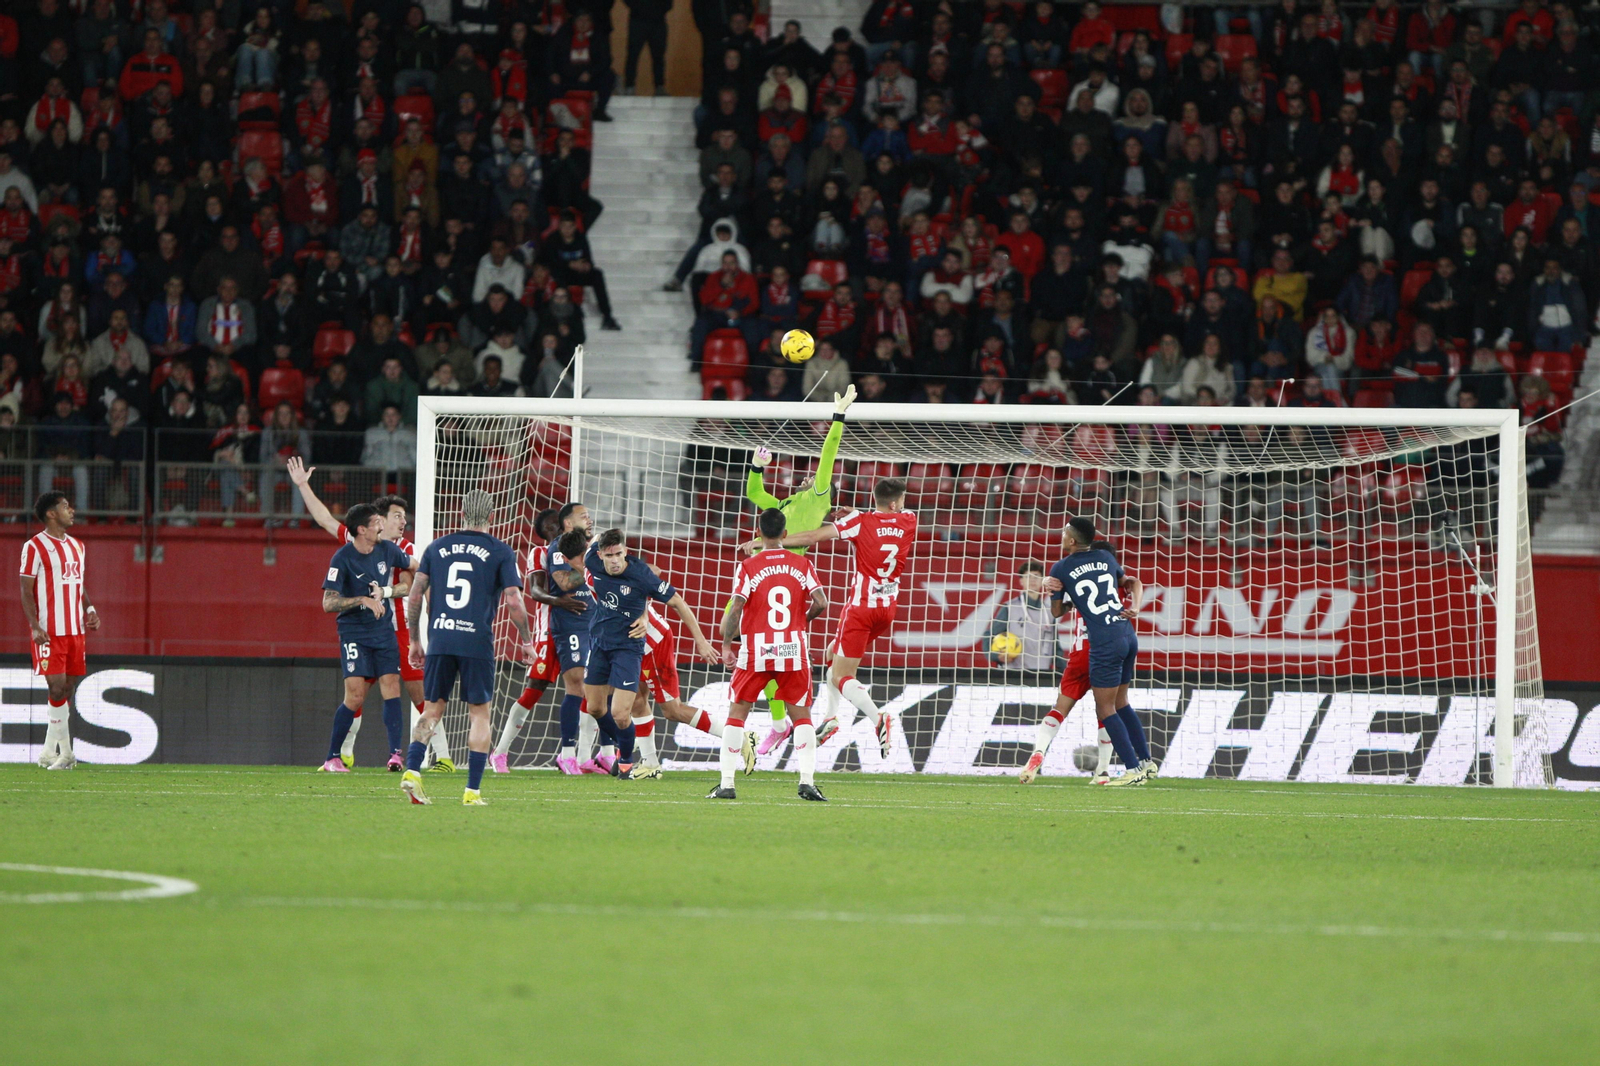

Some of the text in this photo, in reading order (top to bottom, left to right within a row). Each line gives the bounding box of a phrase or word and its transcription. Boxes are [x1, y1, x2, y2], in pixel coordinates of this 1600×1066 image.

[876, 527, 904, 538] EDGAR
[438, 544, 491, 562] R. DE PAUL
[876, 544, 899, 578] 3
[750, 564, 789, 592] JONATHAN
[1069, 562, 1108, 580] REINILDO
[445, 561, 473, 609] 5
[1075, 573, 1123, 615] 23
[767, 585, 791, 630] 8
[433, 612, 474, 630] ria Money
[455, 625, 476, 633] Transfer
[39, 642, 50, 658] 15
[343, 642, 359, 660] 15
[569, 634, 579, 650] 9
[778, 643, 798, 651] POWER
[538, 644, 548, 660] 4
[661, 682, 1600, 791] SKECHER
